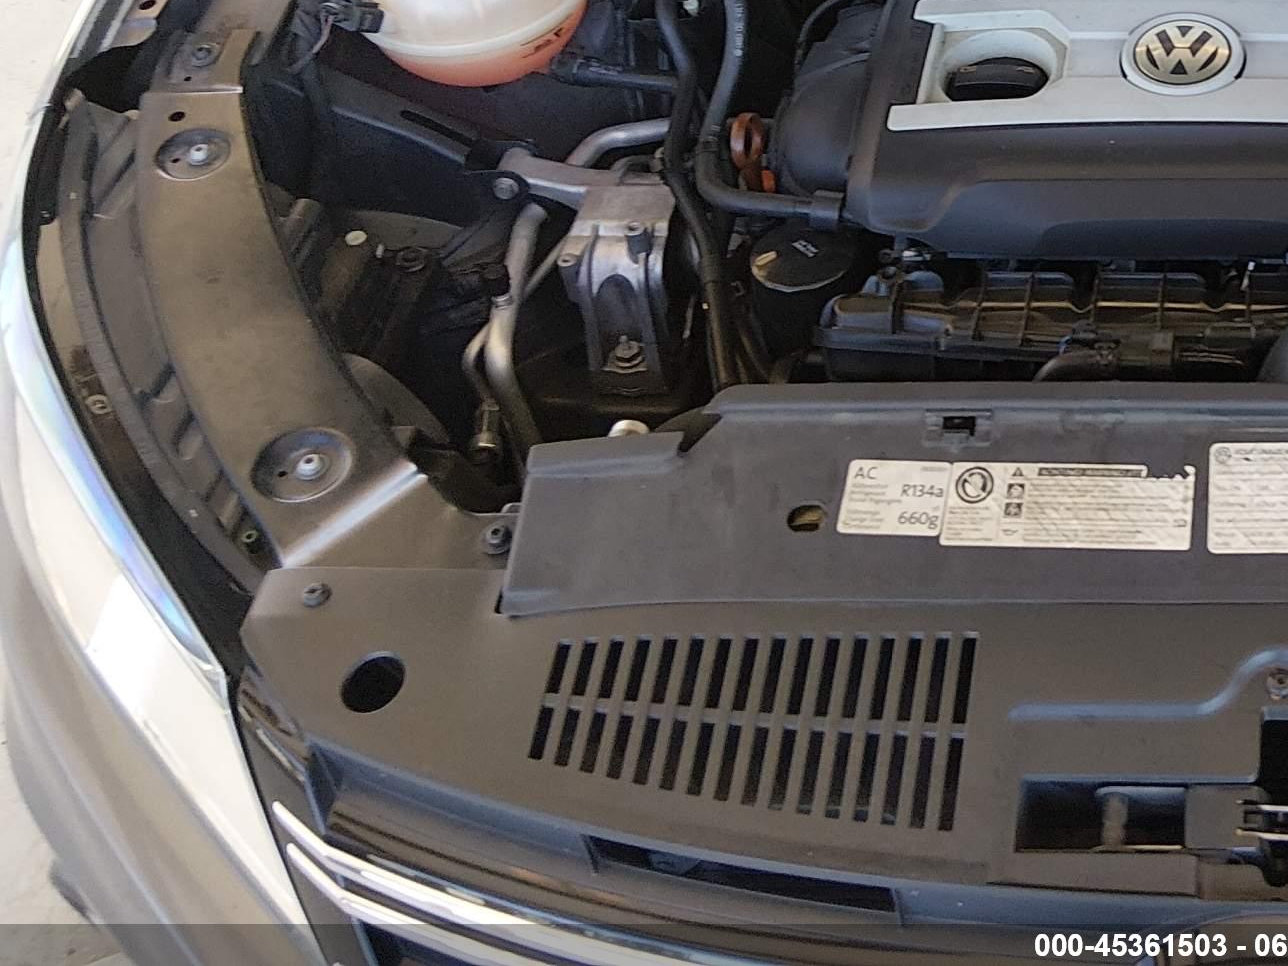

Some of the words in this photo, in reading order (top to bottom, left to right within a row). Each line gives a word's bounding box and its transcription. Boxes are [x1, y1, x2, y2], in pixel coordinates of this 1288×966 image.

[1132, 18, 1232, 86] VW
[853, 465, 878, 480] AC
[900, 483, 944, 498] R134a
[897, 510, 940, 530] 660g
